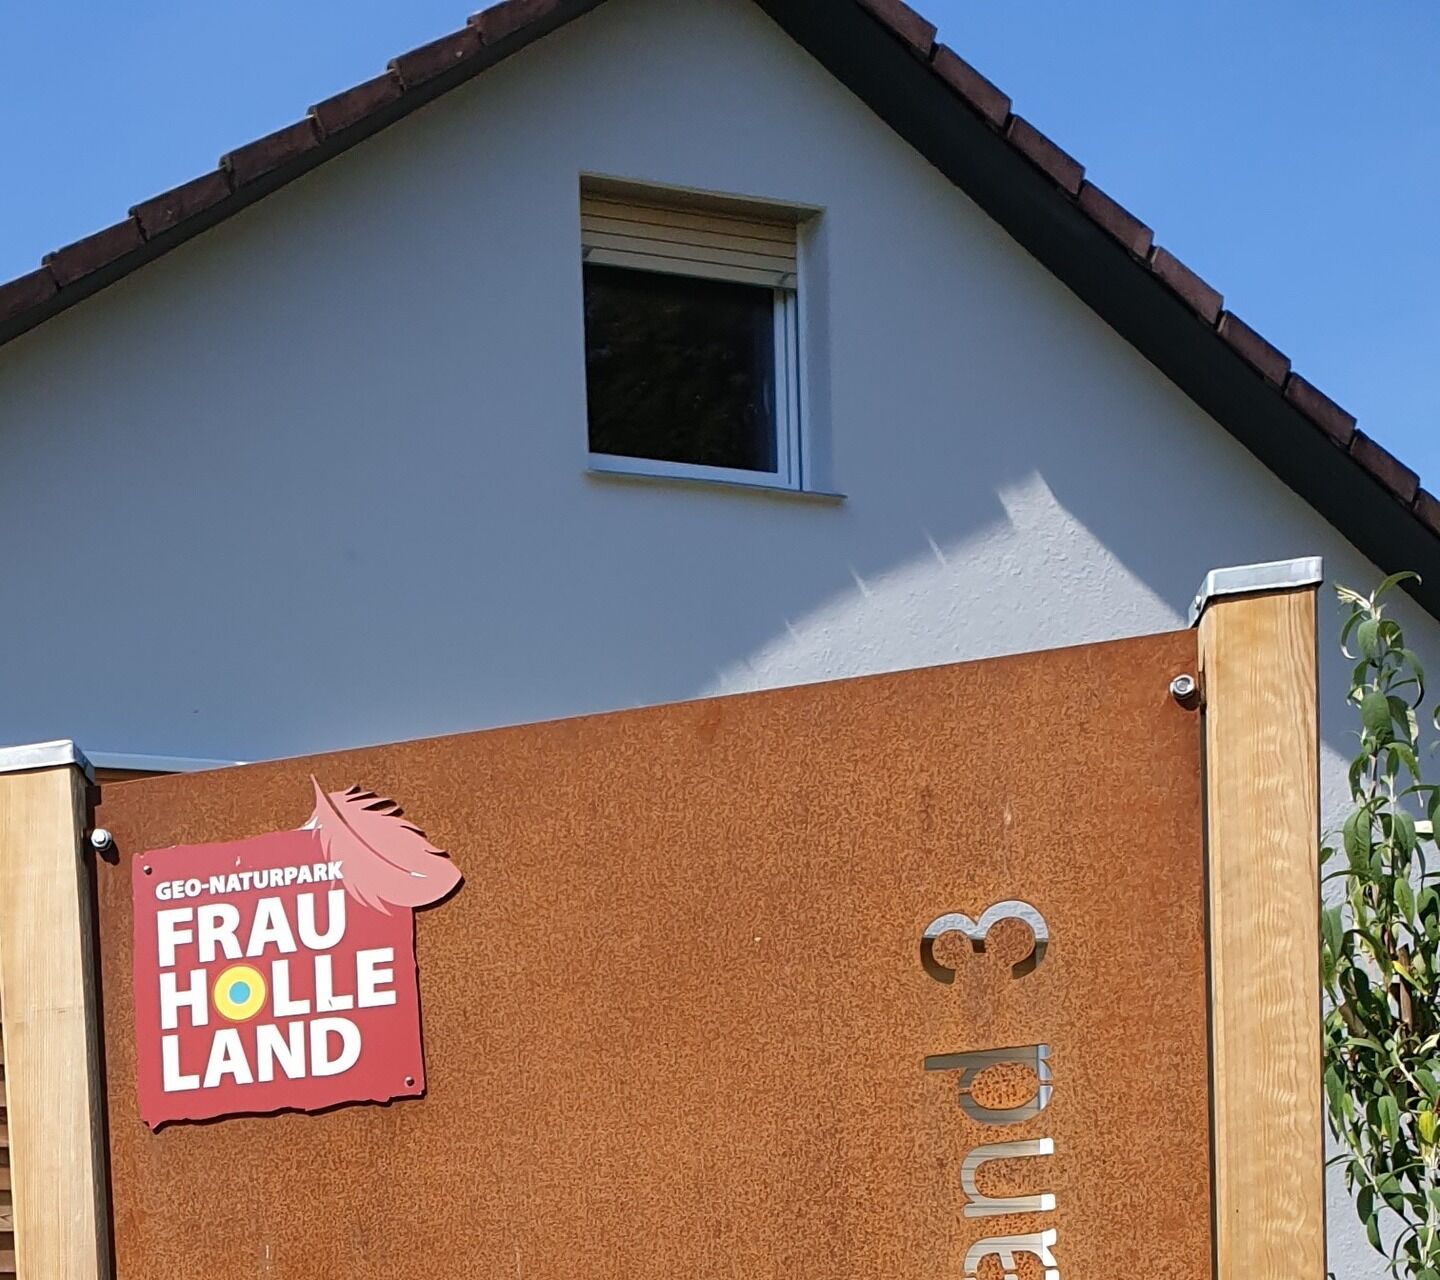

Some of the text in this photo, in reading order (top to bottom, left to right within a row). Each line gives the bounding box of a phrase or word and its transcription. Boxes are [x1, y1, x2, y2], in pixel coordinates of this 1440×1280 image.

[155, 860, 344, 901] GEO-NATURPARK
[156, 888, 347, 968] FRAU
[919, 899, 1050, 985] 3
[159, 946, 397, 1030] HOLLE
[161, 1016, 362, 1093] LAND
